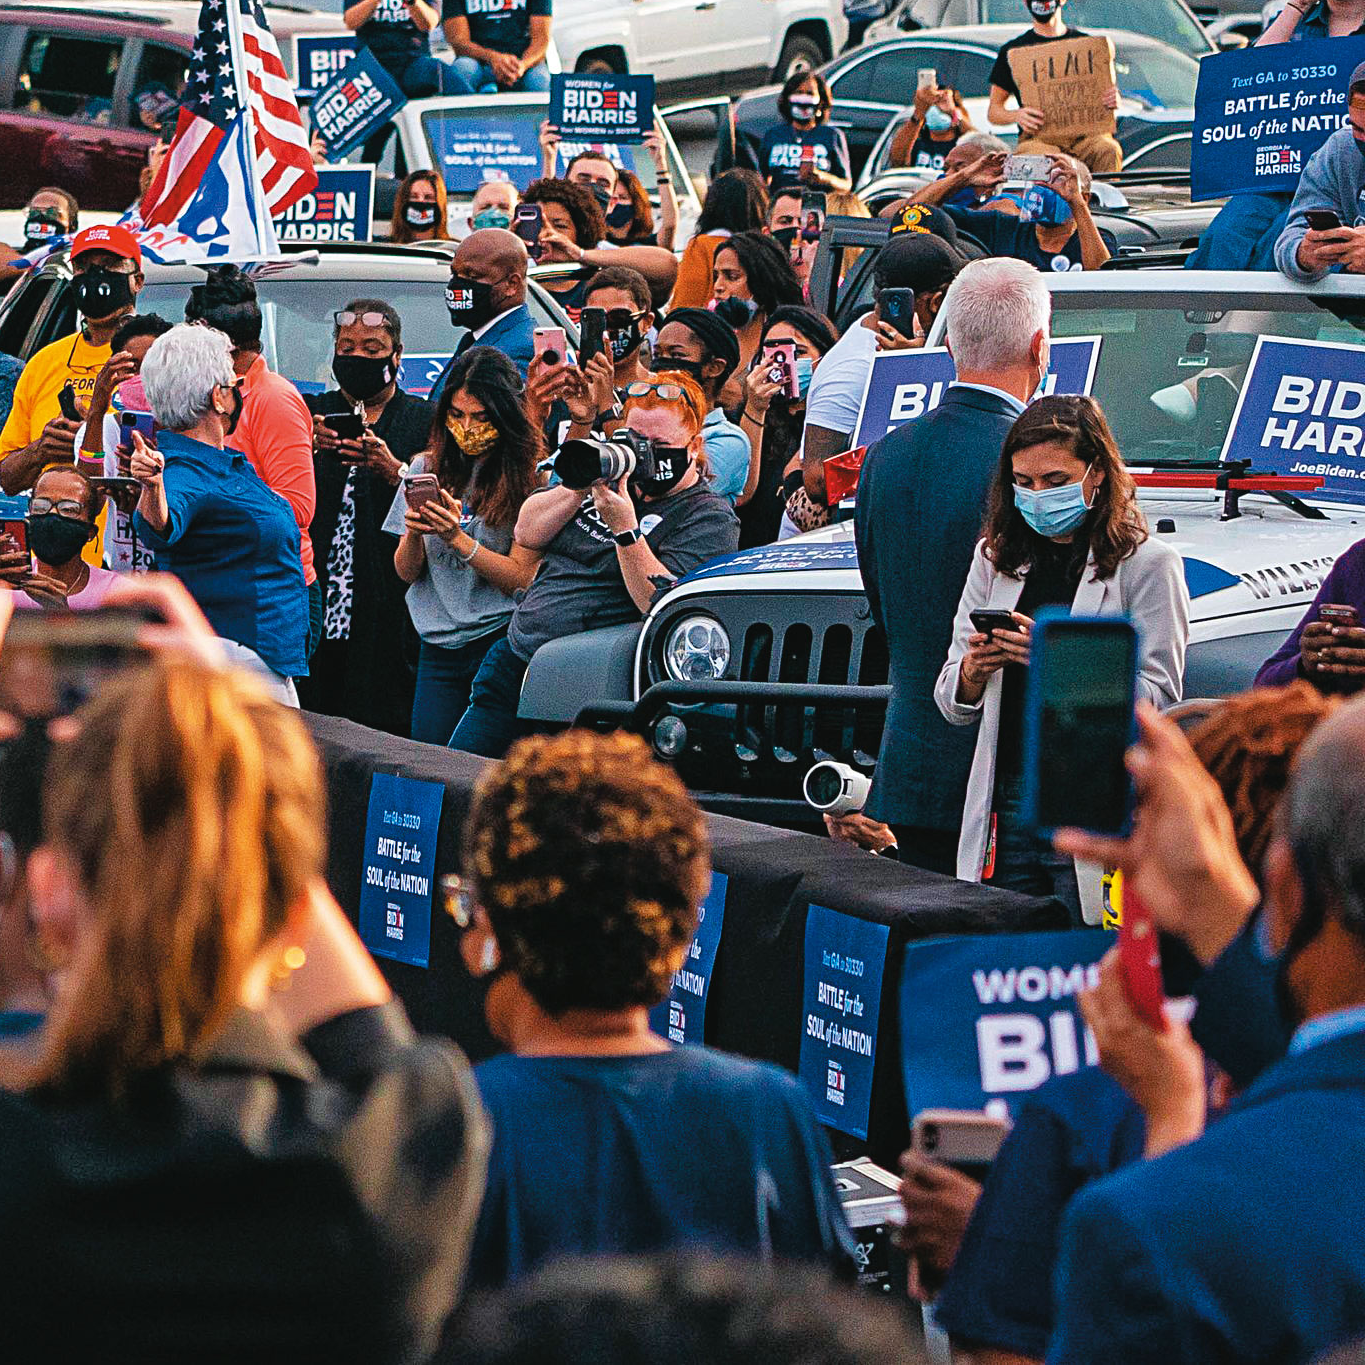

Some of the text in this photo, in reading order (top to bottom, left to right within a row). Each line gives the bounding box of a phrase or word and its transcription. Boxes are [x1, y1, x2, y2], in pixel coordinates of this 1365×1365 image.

[565, 80, 602, 88] WOMEN
[1231, 64, 1337, 89] Text GA to 30330
[315, 71, 375, 128] BIDEN
[563, 89, 637, 109] BIDEN
[1224, 88, 1346, 116] BATTLE for the
[321, 86, 384, 142] HARRIS
[562, 108, 638, 124] HARRIS
[1201, 119, 1288, 145] SOUL of the
[1255, 150, 1301, 165] BIDEN
[1255, 164, 1302, 176] HARRIS
[1272, 375, 1365, 420] BID
[377, 837, 422, 864] BATTLE for the
[366, 865, 429, 897] SOUL NATION
[386, 910, 404, 928] BIDEN
[690, 938, 702, 960] the
[972, 962, 1101, 1005] WOM
[818, 981, 864, 1017] BATTLE for the
[806, 1014, 872, 1057] SOUL NATION
